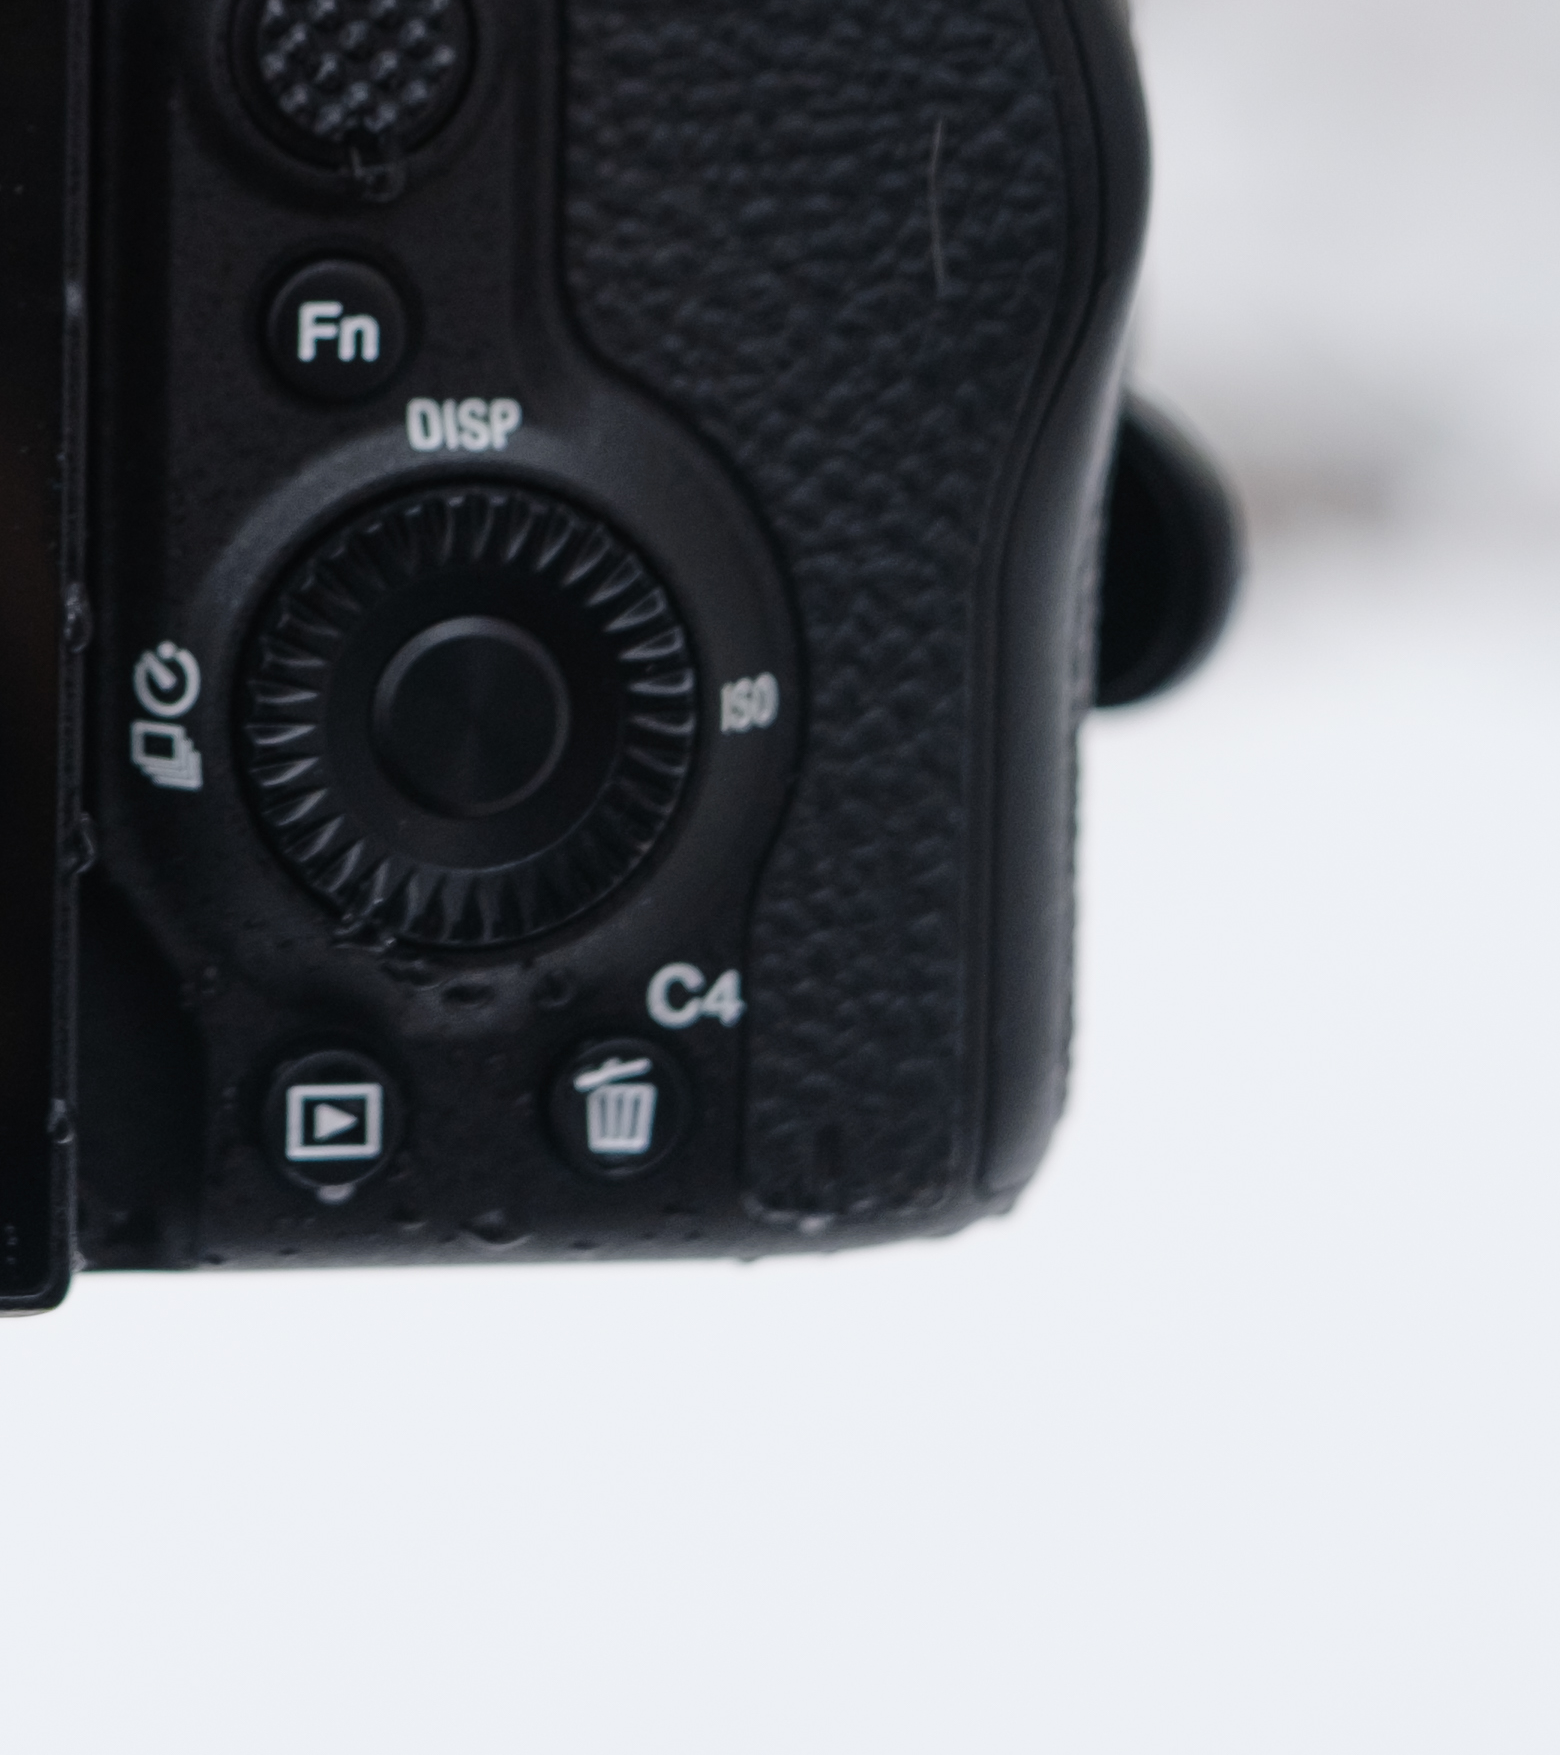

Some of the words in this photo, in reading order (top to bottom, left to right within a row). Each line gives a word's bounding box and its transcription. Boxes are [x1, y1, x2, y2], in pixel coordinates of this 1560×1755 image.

[297, 300, 380, 363] Fn
[406, 397, 523, 452] DISP
[719, 671, 779, 734] ISO
[645, 961, 747, 1029] C4
